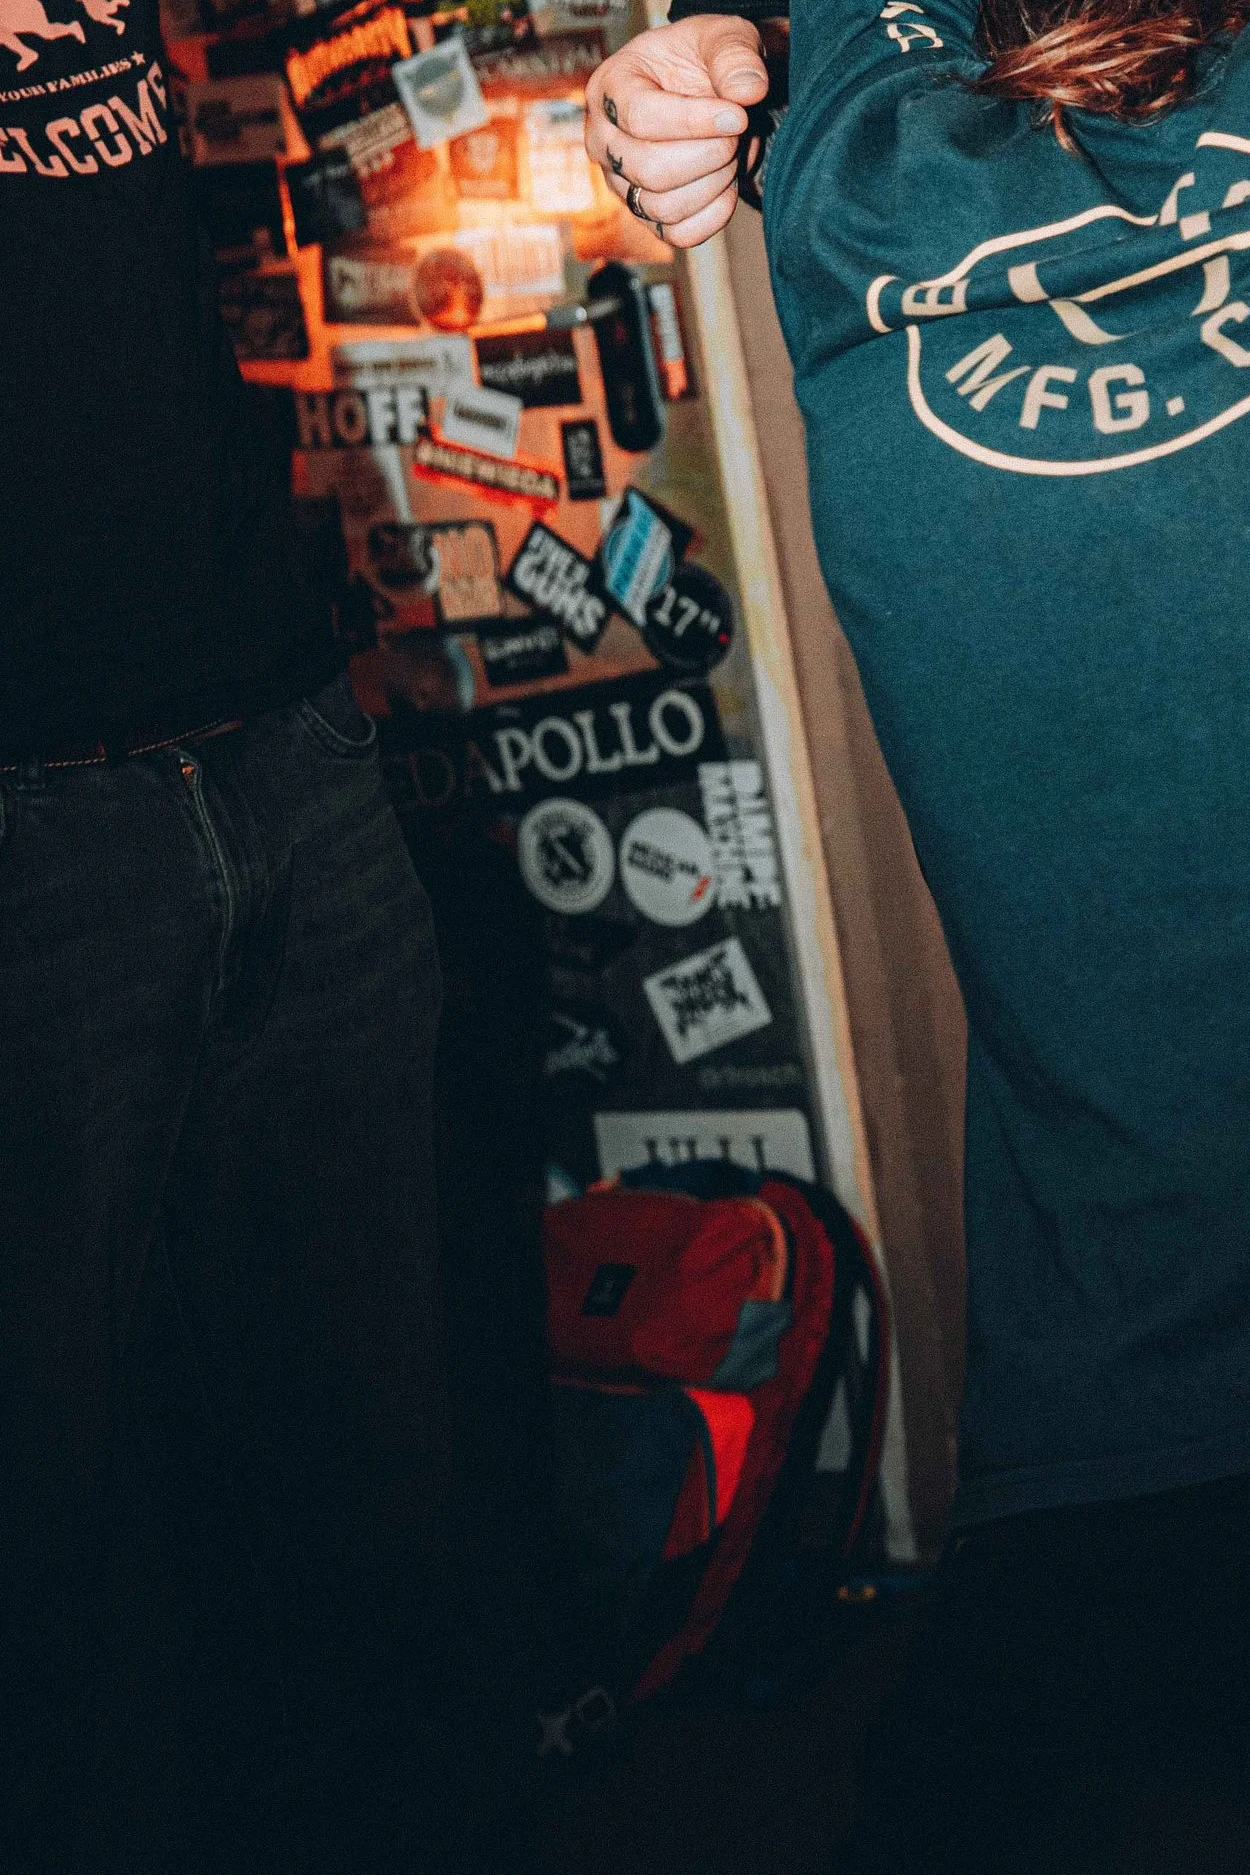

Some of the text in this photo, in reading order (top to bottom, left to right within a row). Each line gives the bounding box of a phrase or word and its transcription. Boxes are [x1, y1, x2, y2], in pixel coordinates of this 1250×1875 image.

[46, 57, 132, 94] FAMILIES
[945, 332, 1186, 434] MFG.
[295, 387, 425, 447] HOFF
